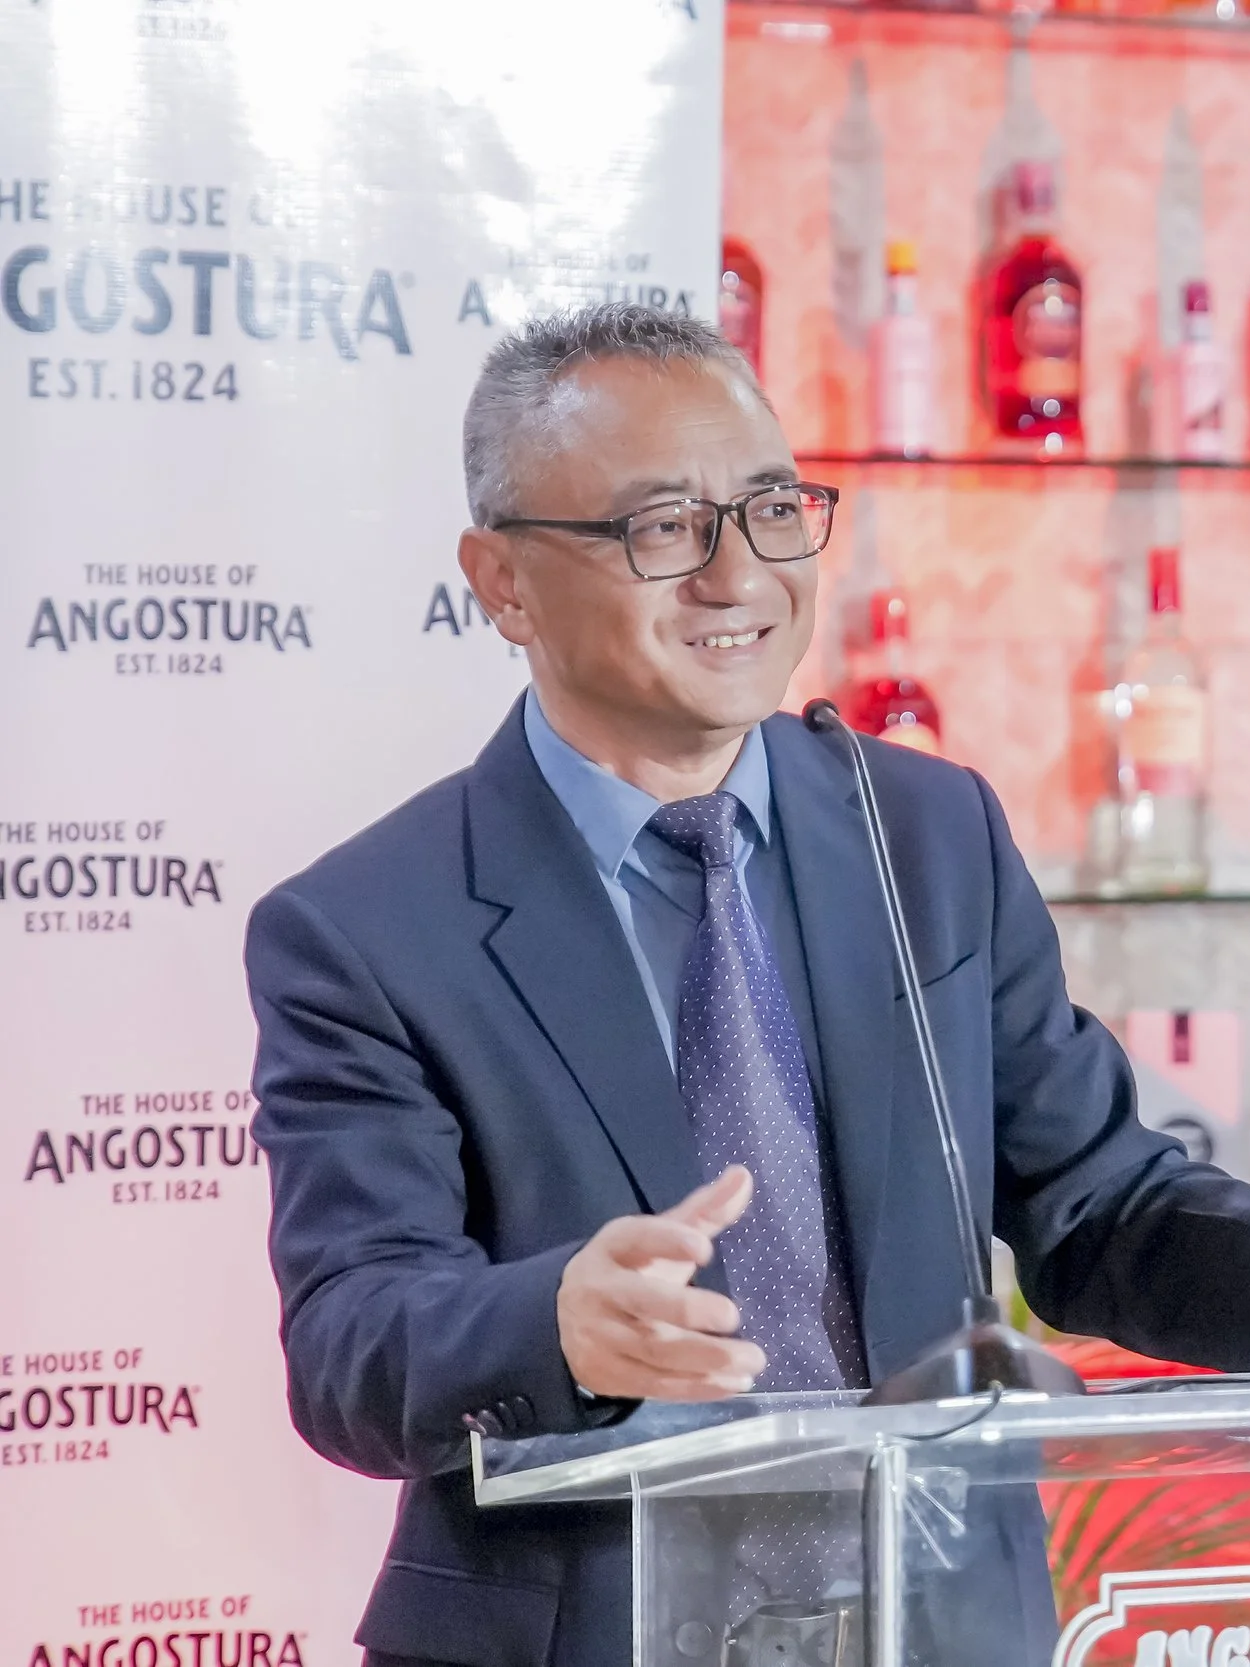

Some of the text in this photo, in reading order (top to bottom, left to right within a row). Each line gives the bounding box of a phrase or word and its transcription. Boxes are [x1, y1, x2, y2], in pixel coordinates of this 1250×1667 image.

[72, 182, 227, 227] USE
[28, 357, 239, 402] EST. 1824
[84, 564, 257, 586] THE HOUSE OF
[27, 597, 311, 652] ANGOSTURA
[116, 653, 223, 674] EST. 1824
[48, 821, 125, 843] HOUSE
[136, 819, 165, 841] OF
[0, 854, 221, 907] GOSTURA
[25, 910, 132, 933] EST. 1824
[82, 1094, 125, 1116] THE
[135, 1091, 213, 1114] HOUSE
[113, 1180, 220, 1204] EST. 1824
[25, 1350, 102, 1375] HOUSE
[114, 1348, 143, 1370] OF
[2, 1440, 109, 1466] EST. 1824
[79, 1595, 250, 1627] THE HOUSE OF
